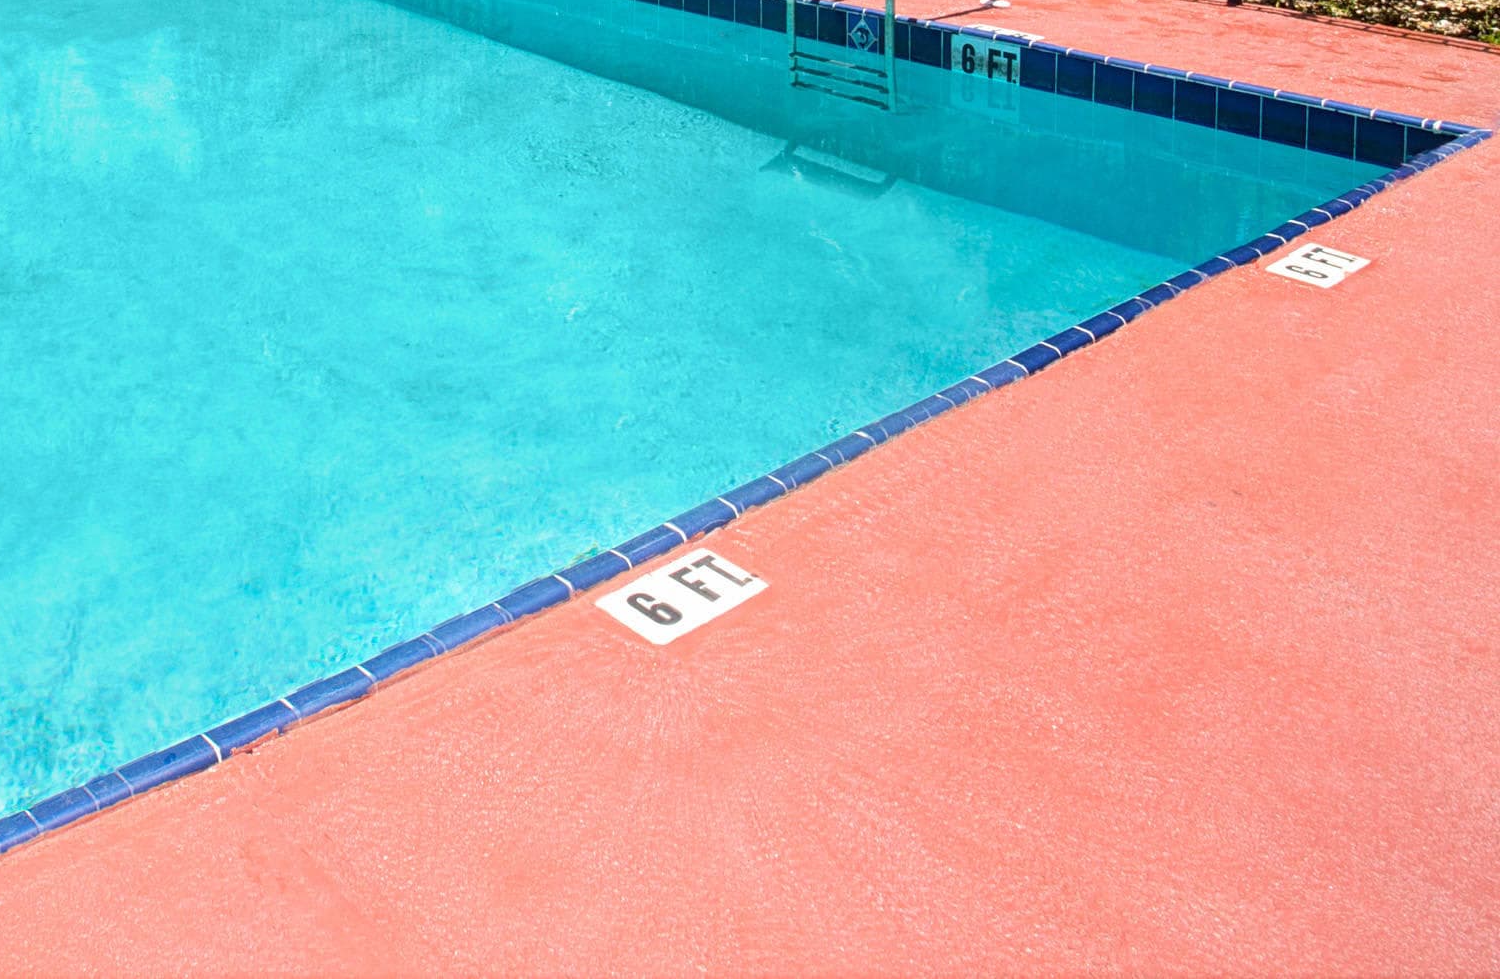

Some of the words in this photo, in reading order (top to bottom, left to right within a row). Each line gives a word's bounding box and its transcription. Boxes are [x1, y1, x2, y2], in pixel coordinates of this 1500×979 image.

[961, 43, 976, 74] 6
[987, 48, 1017, 84] FT.
[1285, 264, 1329, 279] 6
[626, 592, 683, 626] 6
[668, 554, 755, 603] FT.
